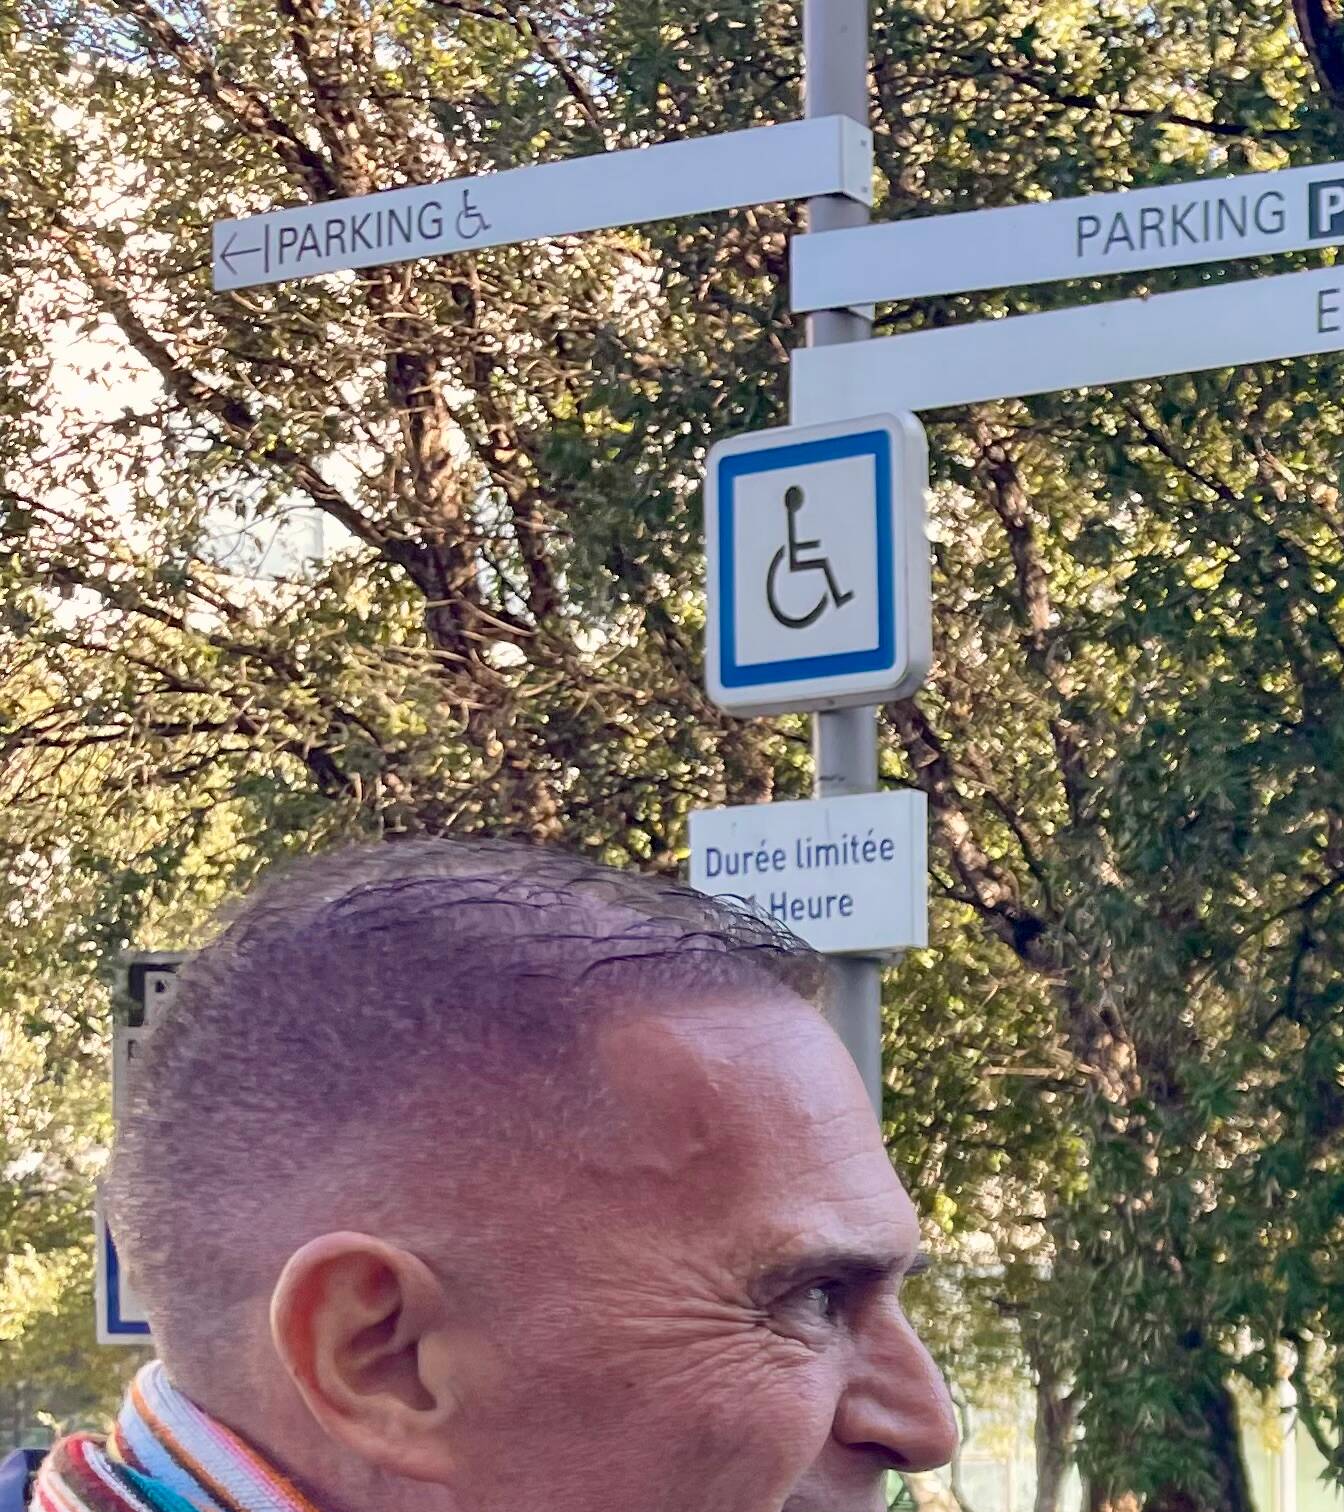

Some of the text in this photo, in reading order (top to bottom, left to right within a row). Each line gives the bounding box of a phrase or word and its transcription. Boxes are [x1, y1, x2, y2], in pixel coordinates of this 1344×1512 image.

[278, 200, 443, 265] PARKING
[1076, 190, 1286, 258] PARKING
[705, 827, 895, 878] Durée limitée
[769, 892, 854, 922] Heure
